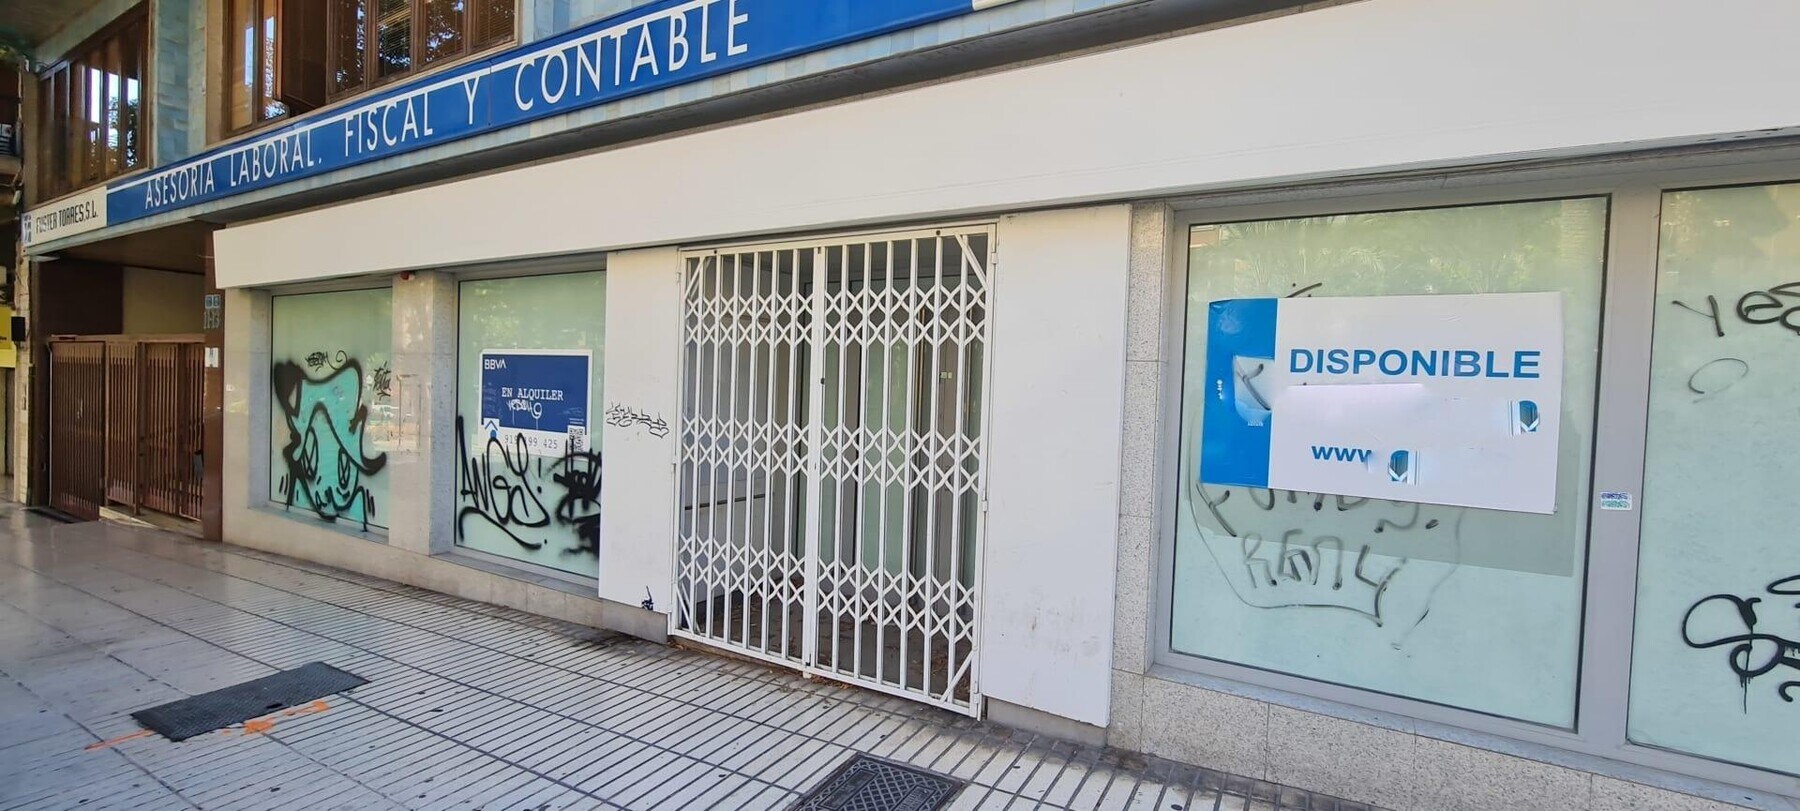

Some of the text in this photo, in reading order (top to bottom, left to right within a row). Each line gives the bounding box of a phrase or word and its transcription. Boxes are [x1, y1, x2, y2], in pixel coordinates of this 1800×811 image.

[345, 93, 433, 157] FISCAL
[463, 70, 481, 126] Y
[515, 0, 748, 112] CONTABLE
[36, 212, 58, 234] FUSTER
[484, 359, 507, 370] BBVA
[1289, 348, 1542, 379] DISPONIBLE
[501, 387, 564, 401] EN ALQUILER
[543, 438, 558, 449] 425
